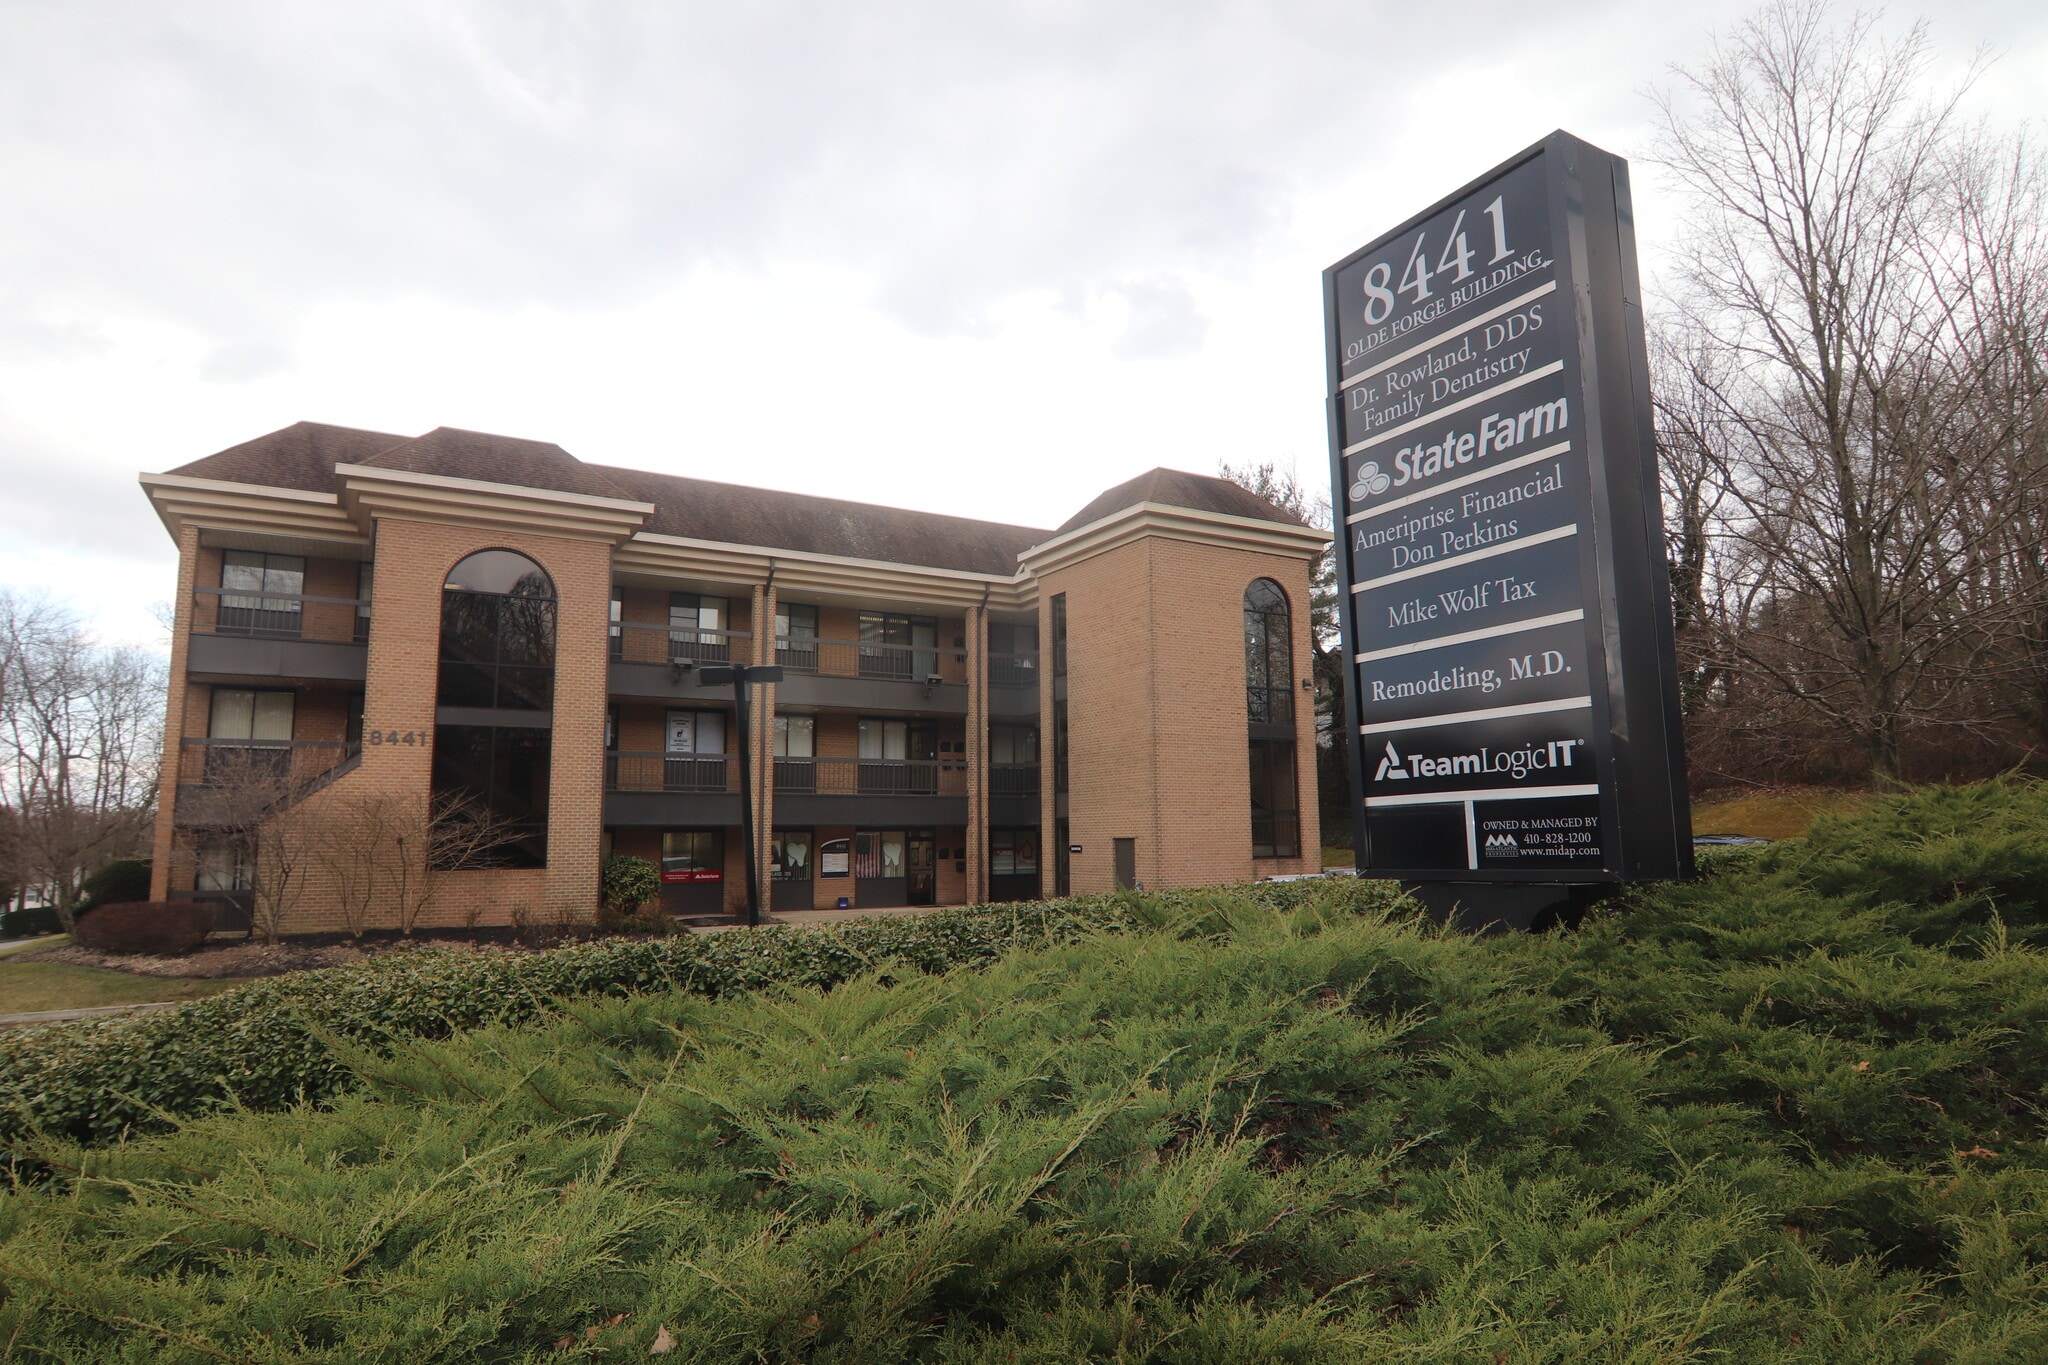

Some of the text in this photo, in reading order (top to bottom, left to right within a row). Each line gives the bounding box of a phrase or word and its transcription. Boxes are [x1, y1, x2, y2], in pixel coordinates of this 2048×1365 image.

[1363, 194, 1515, 326] 8441
[1347, 249, 1545, 360] OLDE FORGE BUILDING
[1351, 304, 1543, 411] Dr. Rowland, DDS
[1363, 347, 1532, 432] Family Dentistry
[1354, 462, 1564, 552] Ameriprise Financial
[1391, 519, 1518, 569] Don Perkins
[1387, 576, 1537, 629] Mike Wolf Tax
[1371, 649, 1572, 702] Remodeling, M.D.
[370, 730, 426, 746] 8441
[1483, 816, 1598, 830] OWNED & MANAGED BY
[1523, 832, 1592, 844] 410-828-1200
[1519, 844, 1600, 859] www.midap.com
